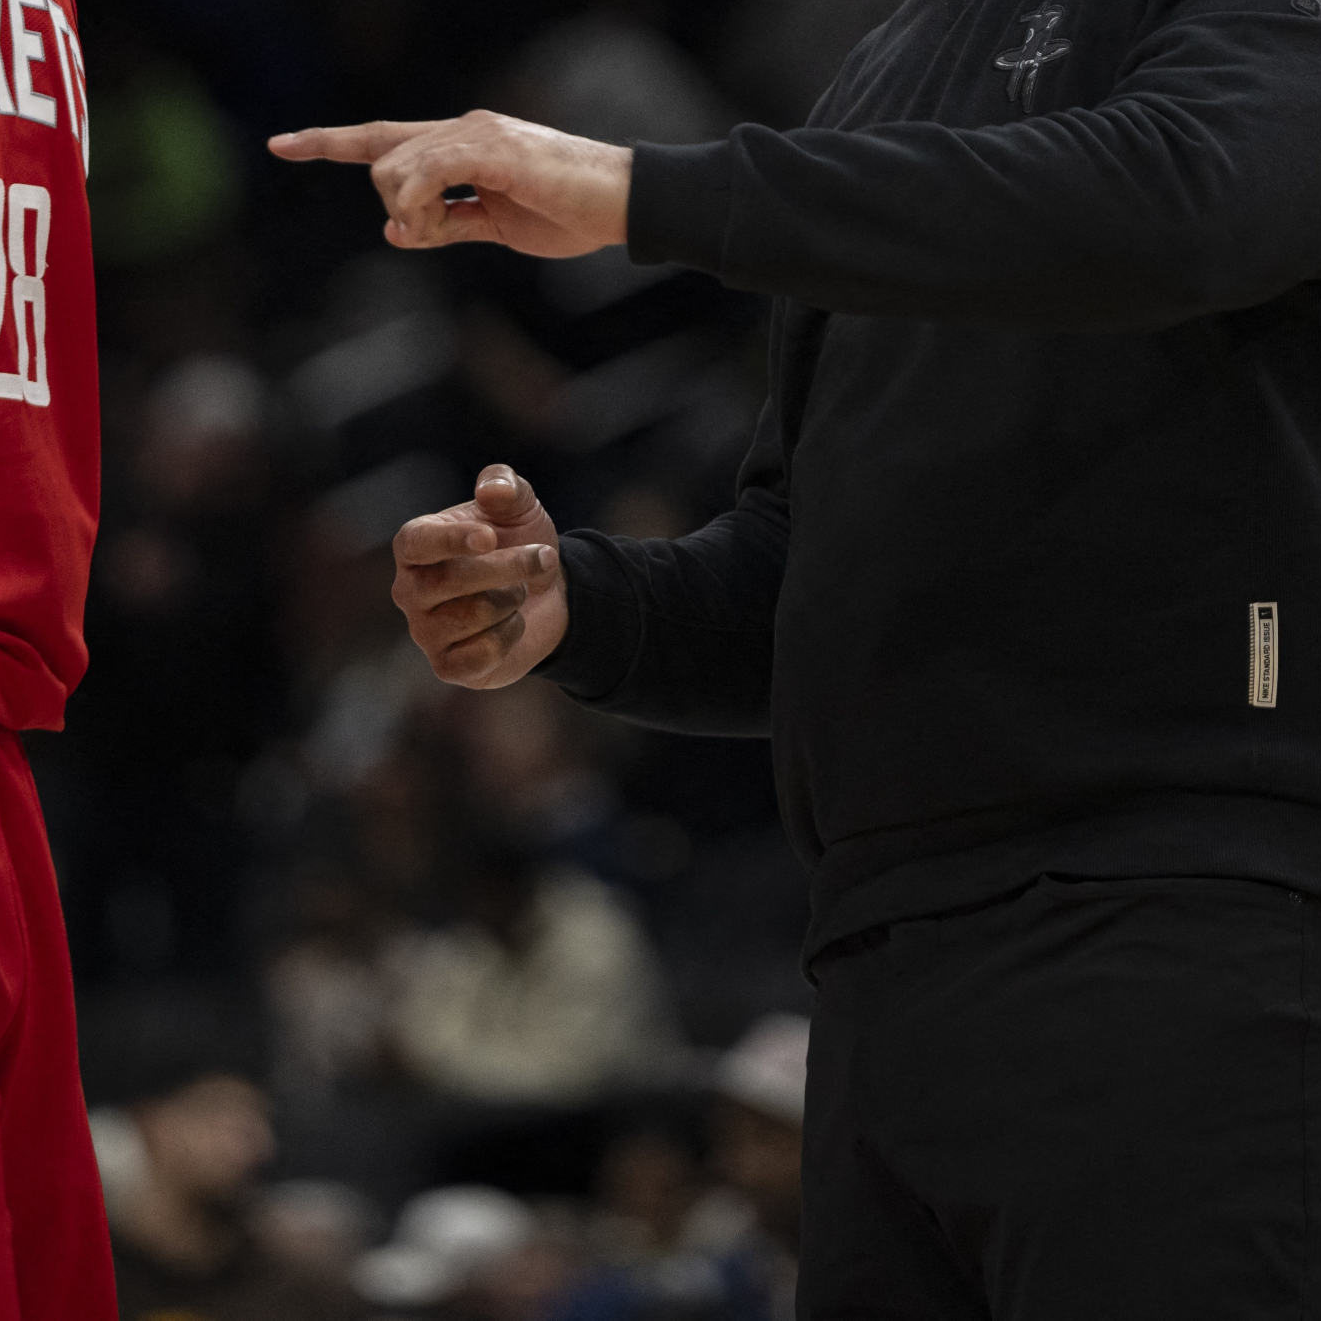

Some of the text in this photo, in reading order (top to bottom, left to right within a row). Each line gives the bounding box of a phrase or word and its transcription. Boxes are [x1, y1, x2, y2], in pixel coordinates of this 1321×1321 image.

[1261, 622, 1271, 699] NIKE STANDARD ISSUE
